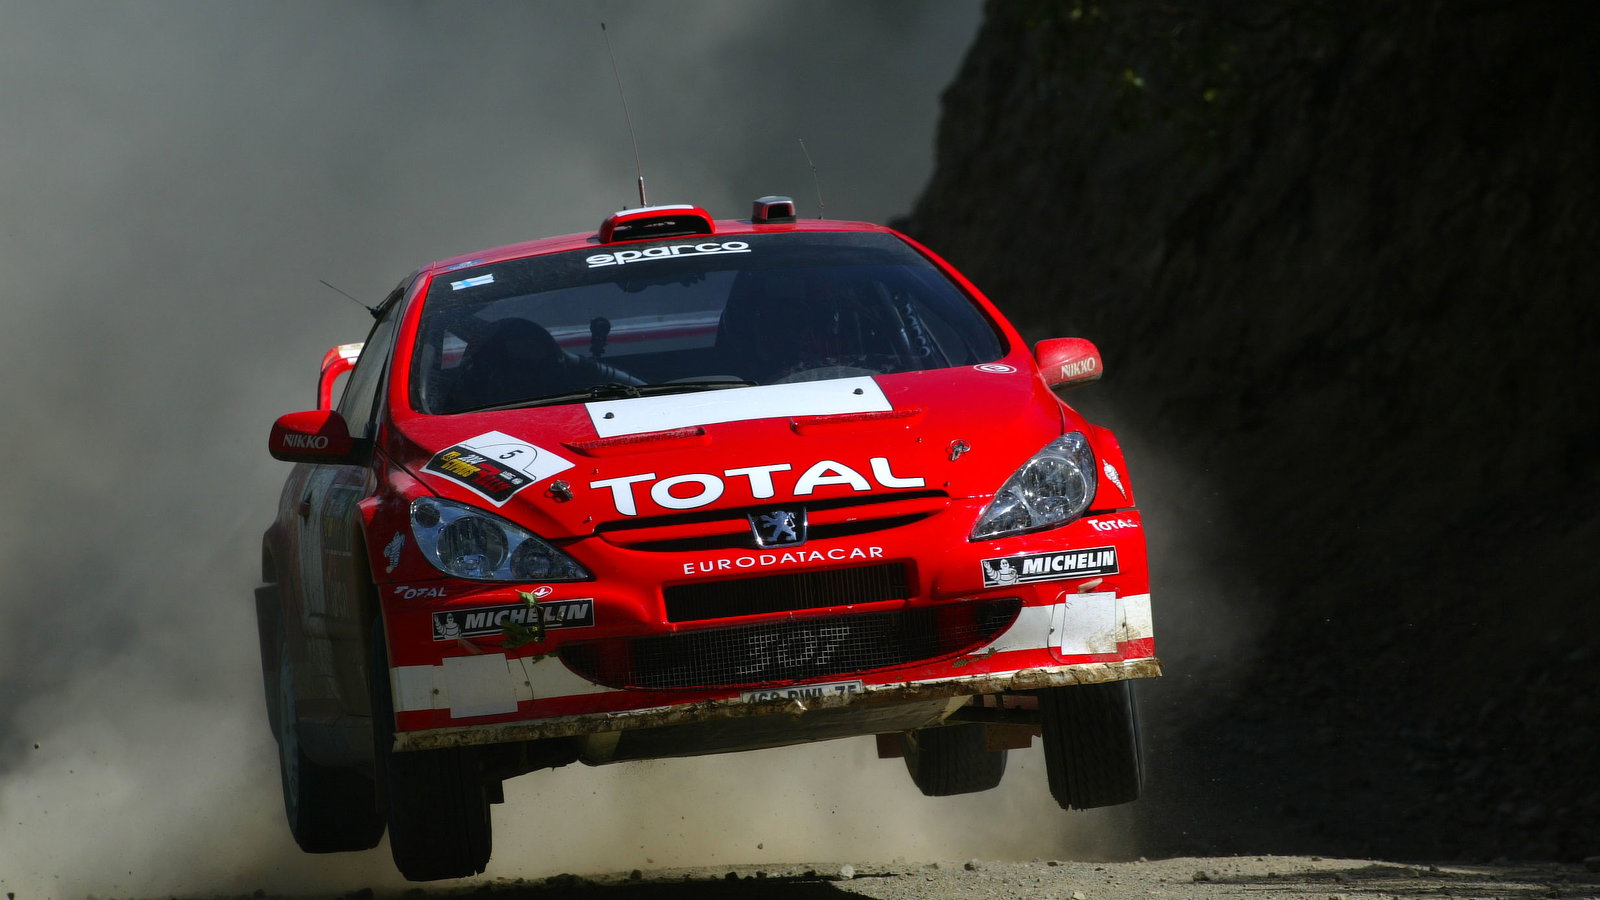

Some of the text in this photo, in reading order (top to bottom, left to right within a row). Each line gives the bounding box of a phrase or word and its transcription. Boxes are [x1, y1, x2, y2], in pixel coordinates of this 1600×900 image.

[586, 241, 751, 268] sparco
[1061, 357, 1096, 379] NIKKO
[282, 433, 329, 449] NIKKO
[498, 449, 524, 460] 5
[590, 457, 926, 517] TOTAL
[1088, 519, 1139, 532] TOTAL
[683, 546, 885, 575] EURODATACAR
[1022, 550, 1115, 574] MICHELIN
[394, 585, 448, 600] TOTAL
[464, 604, 589, 630] MICHELIN
